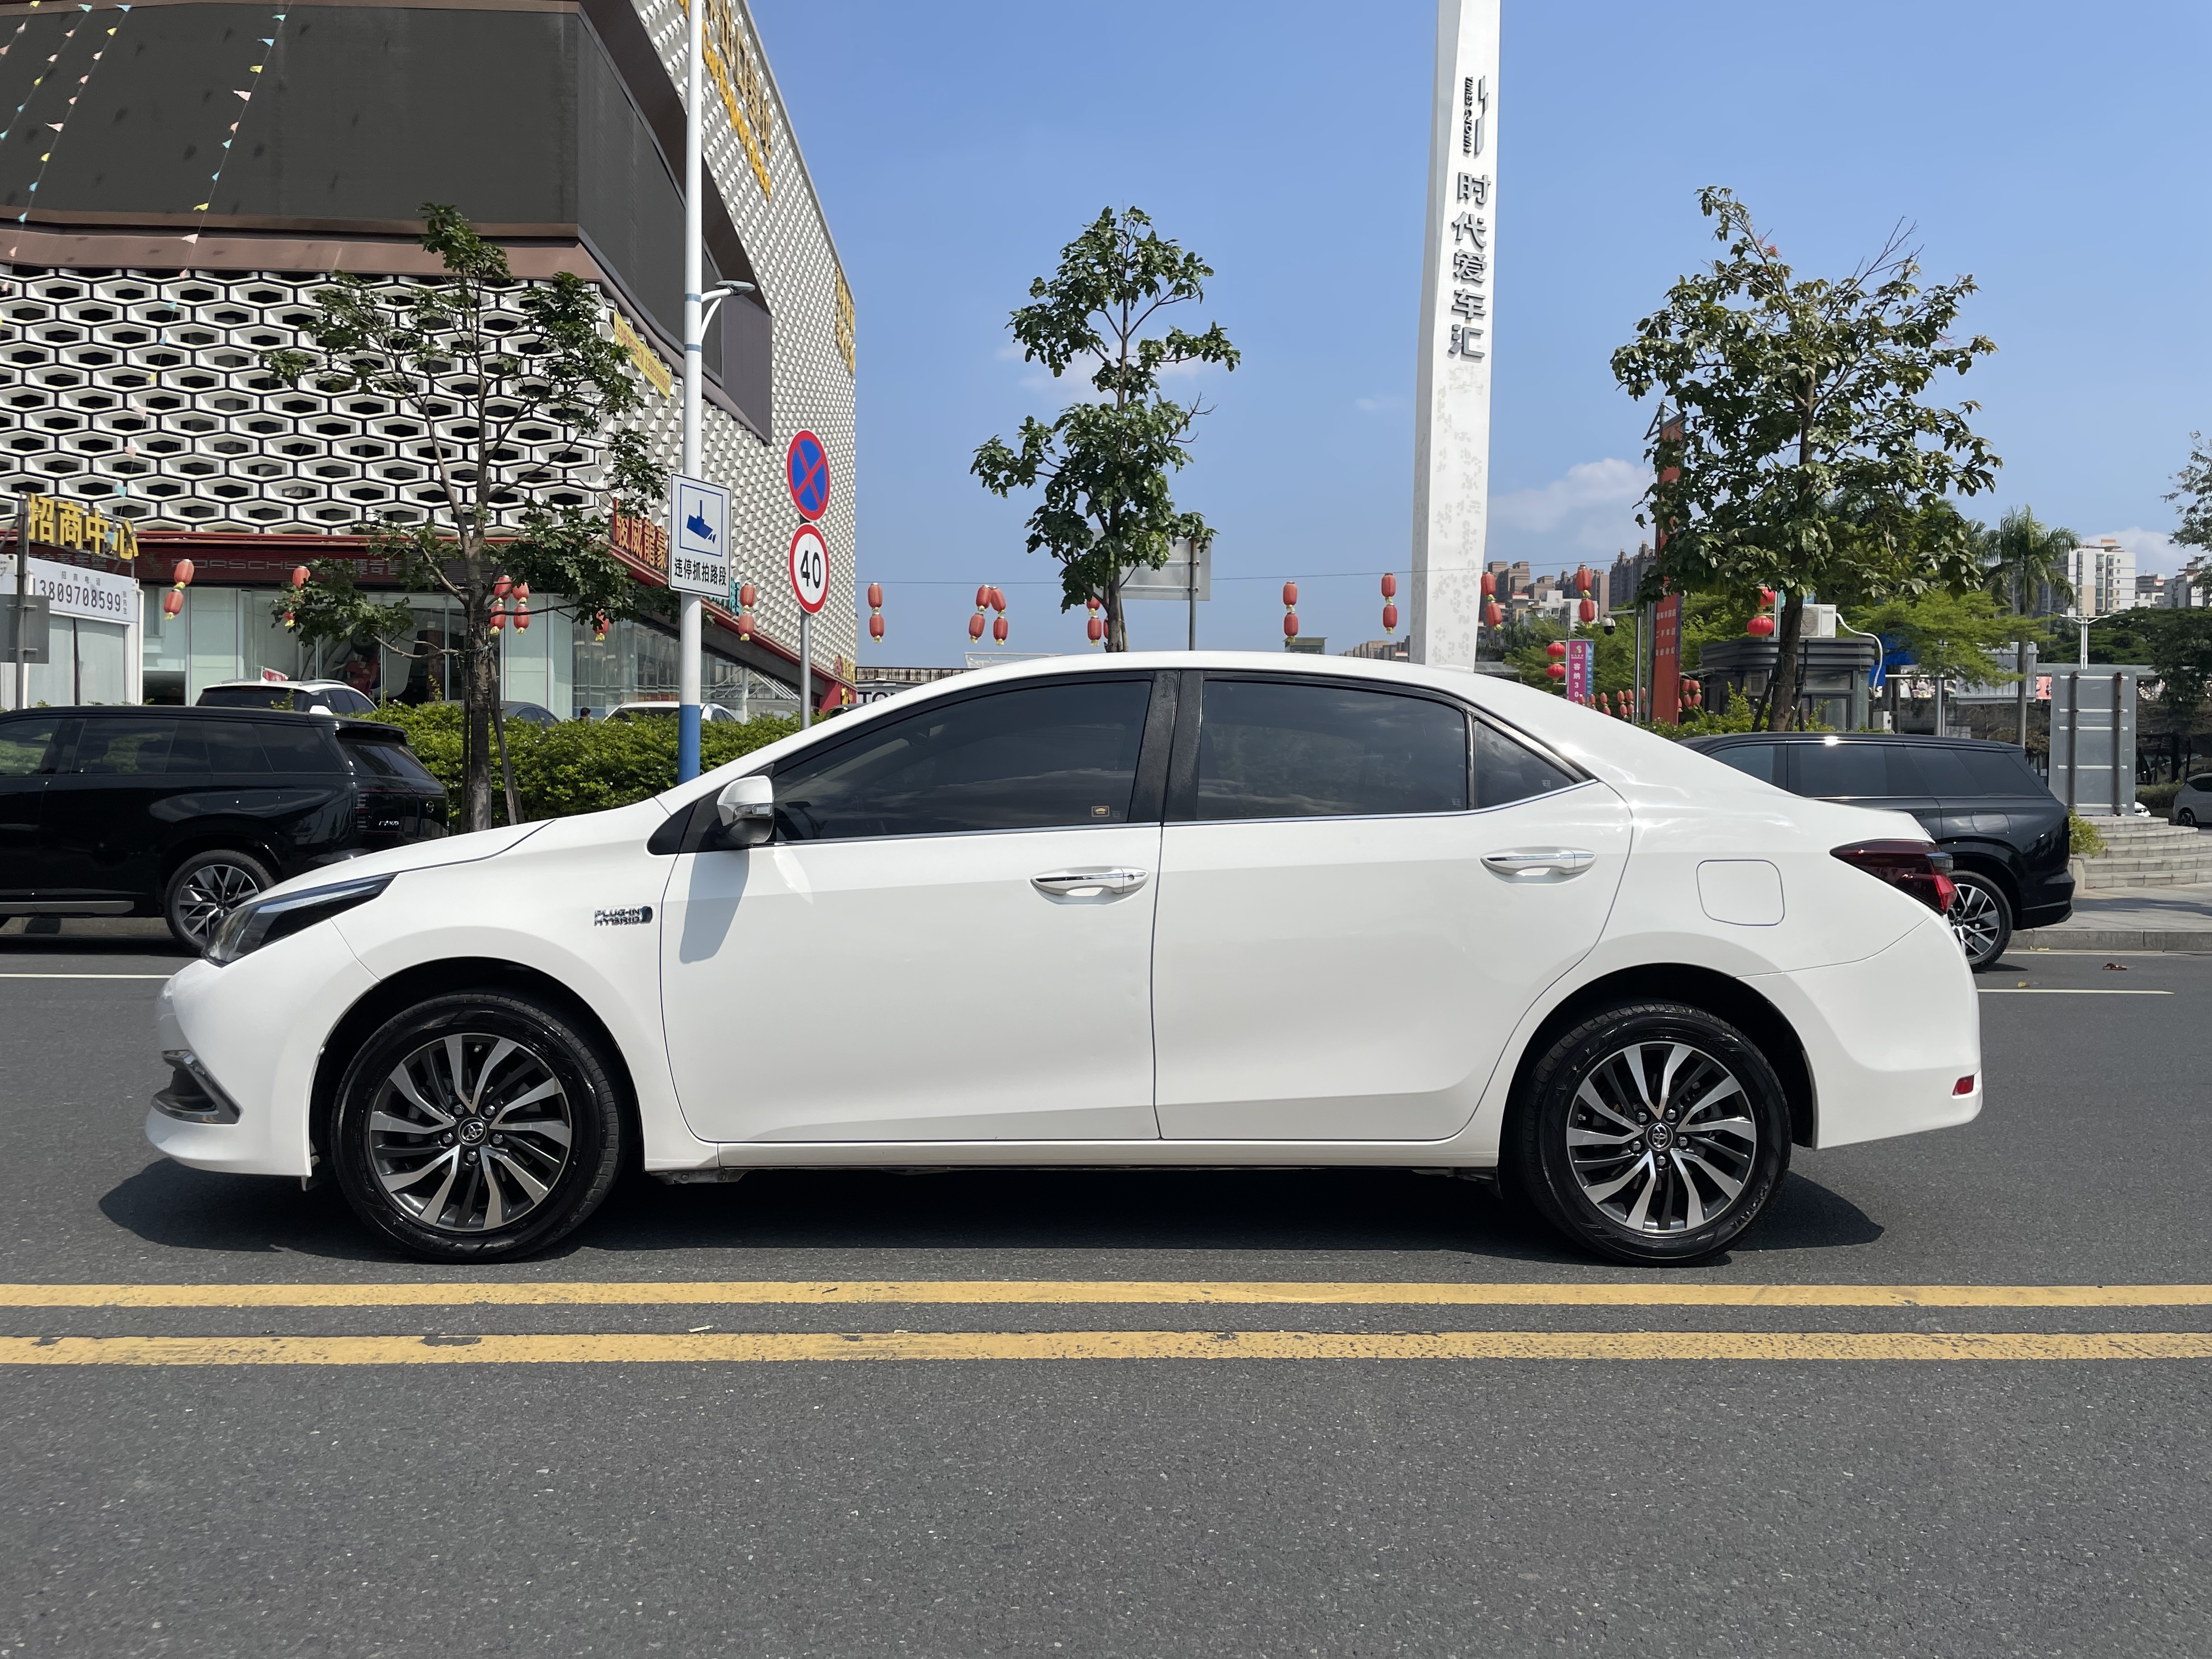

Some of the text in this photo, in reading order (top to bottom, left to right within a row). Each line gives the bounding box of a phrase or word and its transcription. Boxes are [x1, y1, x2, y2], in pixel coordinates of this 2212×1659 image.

[1448, 172, 1491, 358] 时代爱车汇
[29, 492, 139, 560] 招商中心
[674, 557, 727, 586] 违停抓拍路段
[800, 550, 821, 589] 40
[33, 578, 121, 612] 13809708599
[857, 691, 896, 703] TO
[594, 908, 641, 918] PLUG-IN
[594, 916, 640, 926] HYBRID
